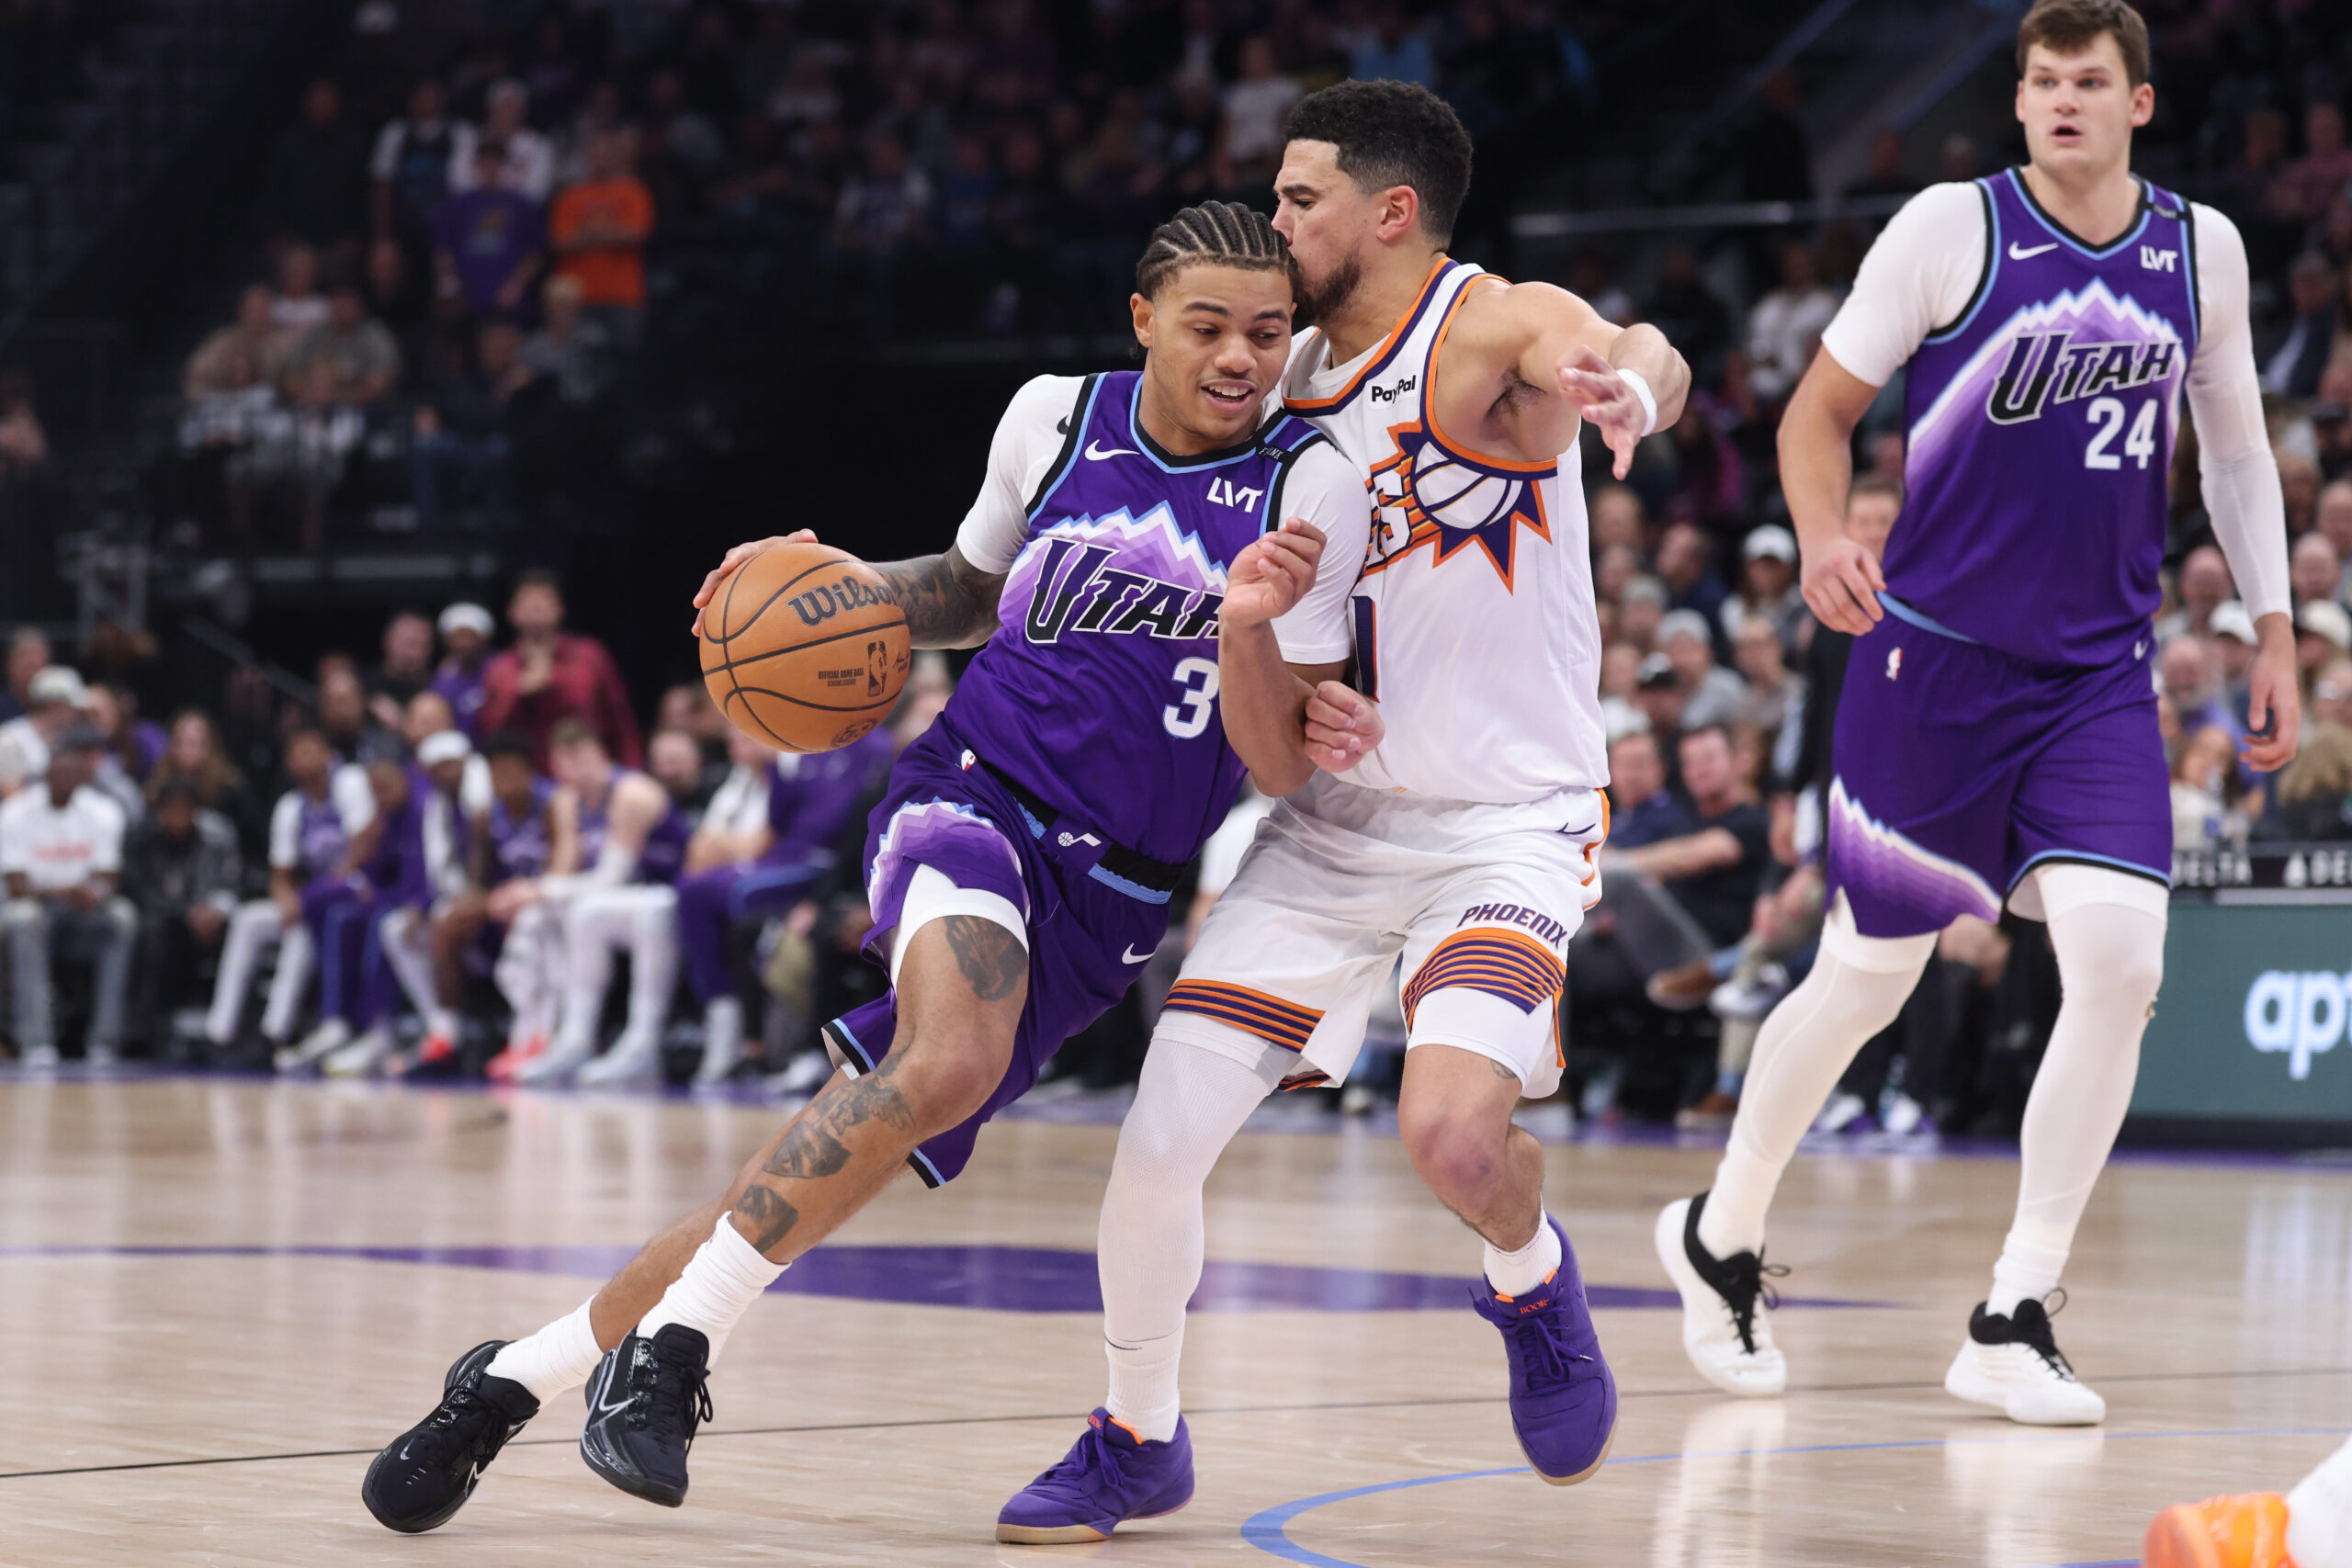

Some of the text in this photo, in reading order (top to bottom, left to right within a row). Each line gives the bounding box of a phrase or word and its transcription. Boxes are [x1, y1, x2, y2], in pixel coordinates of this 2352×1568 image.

[2139, 245, 2178, 273] LVT
[1371, 375, 1417, 404] PayPal
[1986, 329, 2183, 425] UTAH
[2084, 396, 2159, 470] 24
[1206, 476, 1264, 513] LVT
[786, 577, 899, 626] Wilso
[1162, 656, 1220, 739] 3
[1456, 902, 1567, 949] PHOENIX
[2244, 969, 2352, 1081] ap
